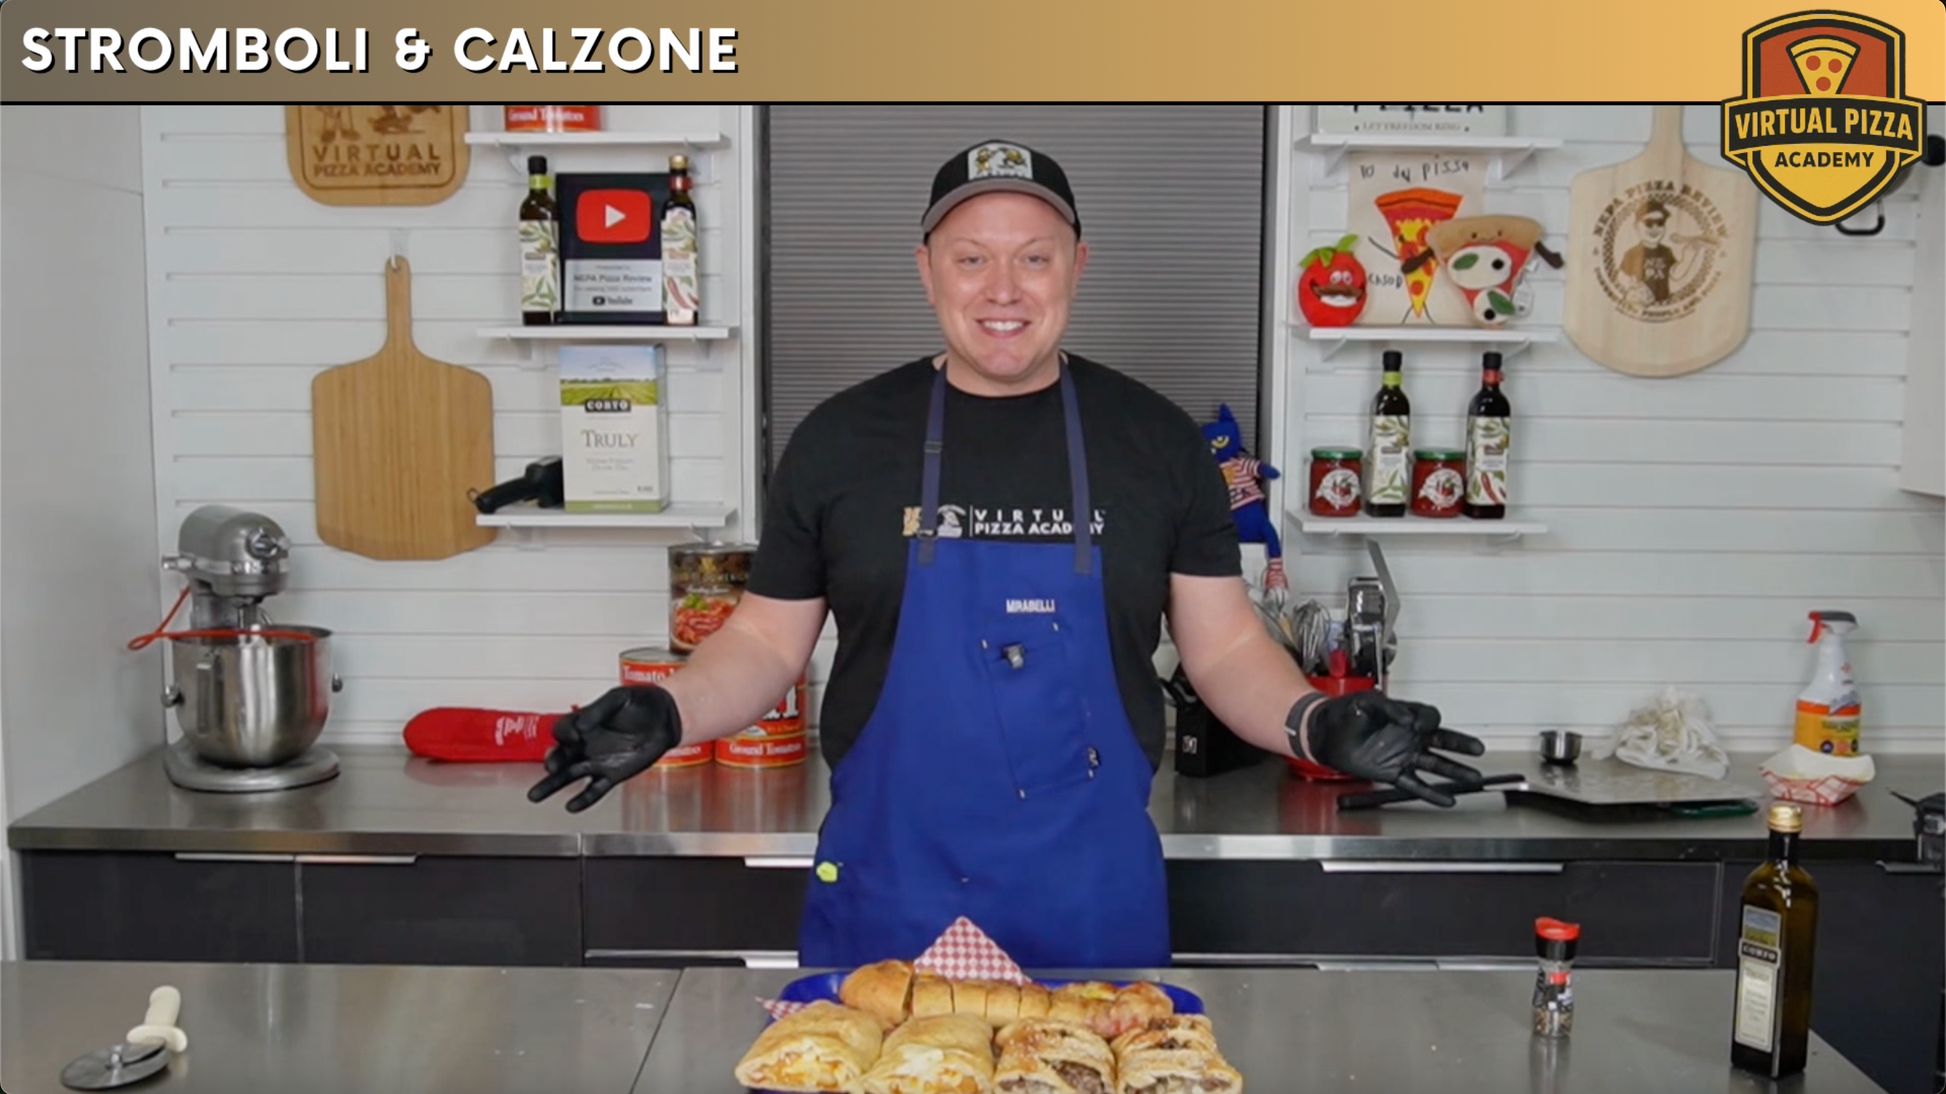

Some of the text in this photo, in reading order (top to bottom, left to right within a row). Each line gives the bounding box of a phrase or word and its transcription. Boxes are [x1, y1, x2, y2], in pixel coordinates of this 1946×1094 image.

[312, 143, 441, 162] VIRTUAL
[312, 162, 441, 178] PIZZA ACADEMY
[1625, 180, 1675, 199] PIZZA
[1680, 184, 1726, 237] REVIEW
[974, 508, 1104, 523] VIRTUL
[974, 522, 1105, 535] PIZZA ACADY
[1006, 599, 1056, 614] MIRABELLI
